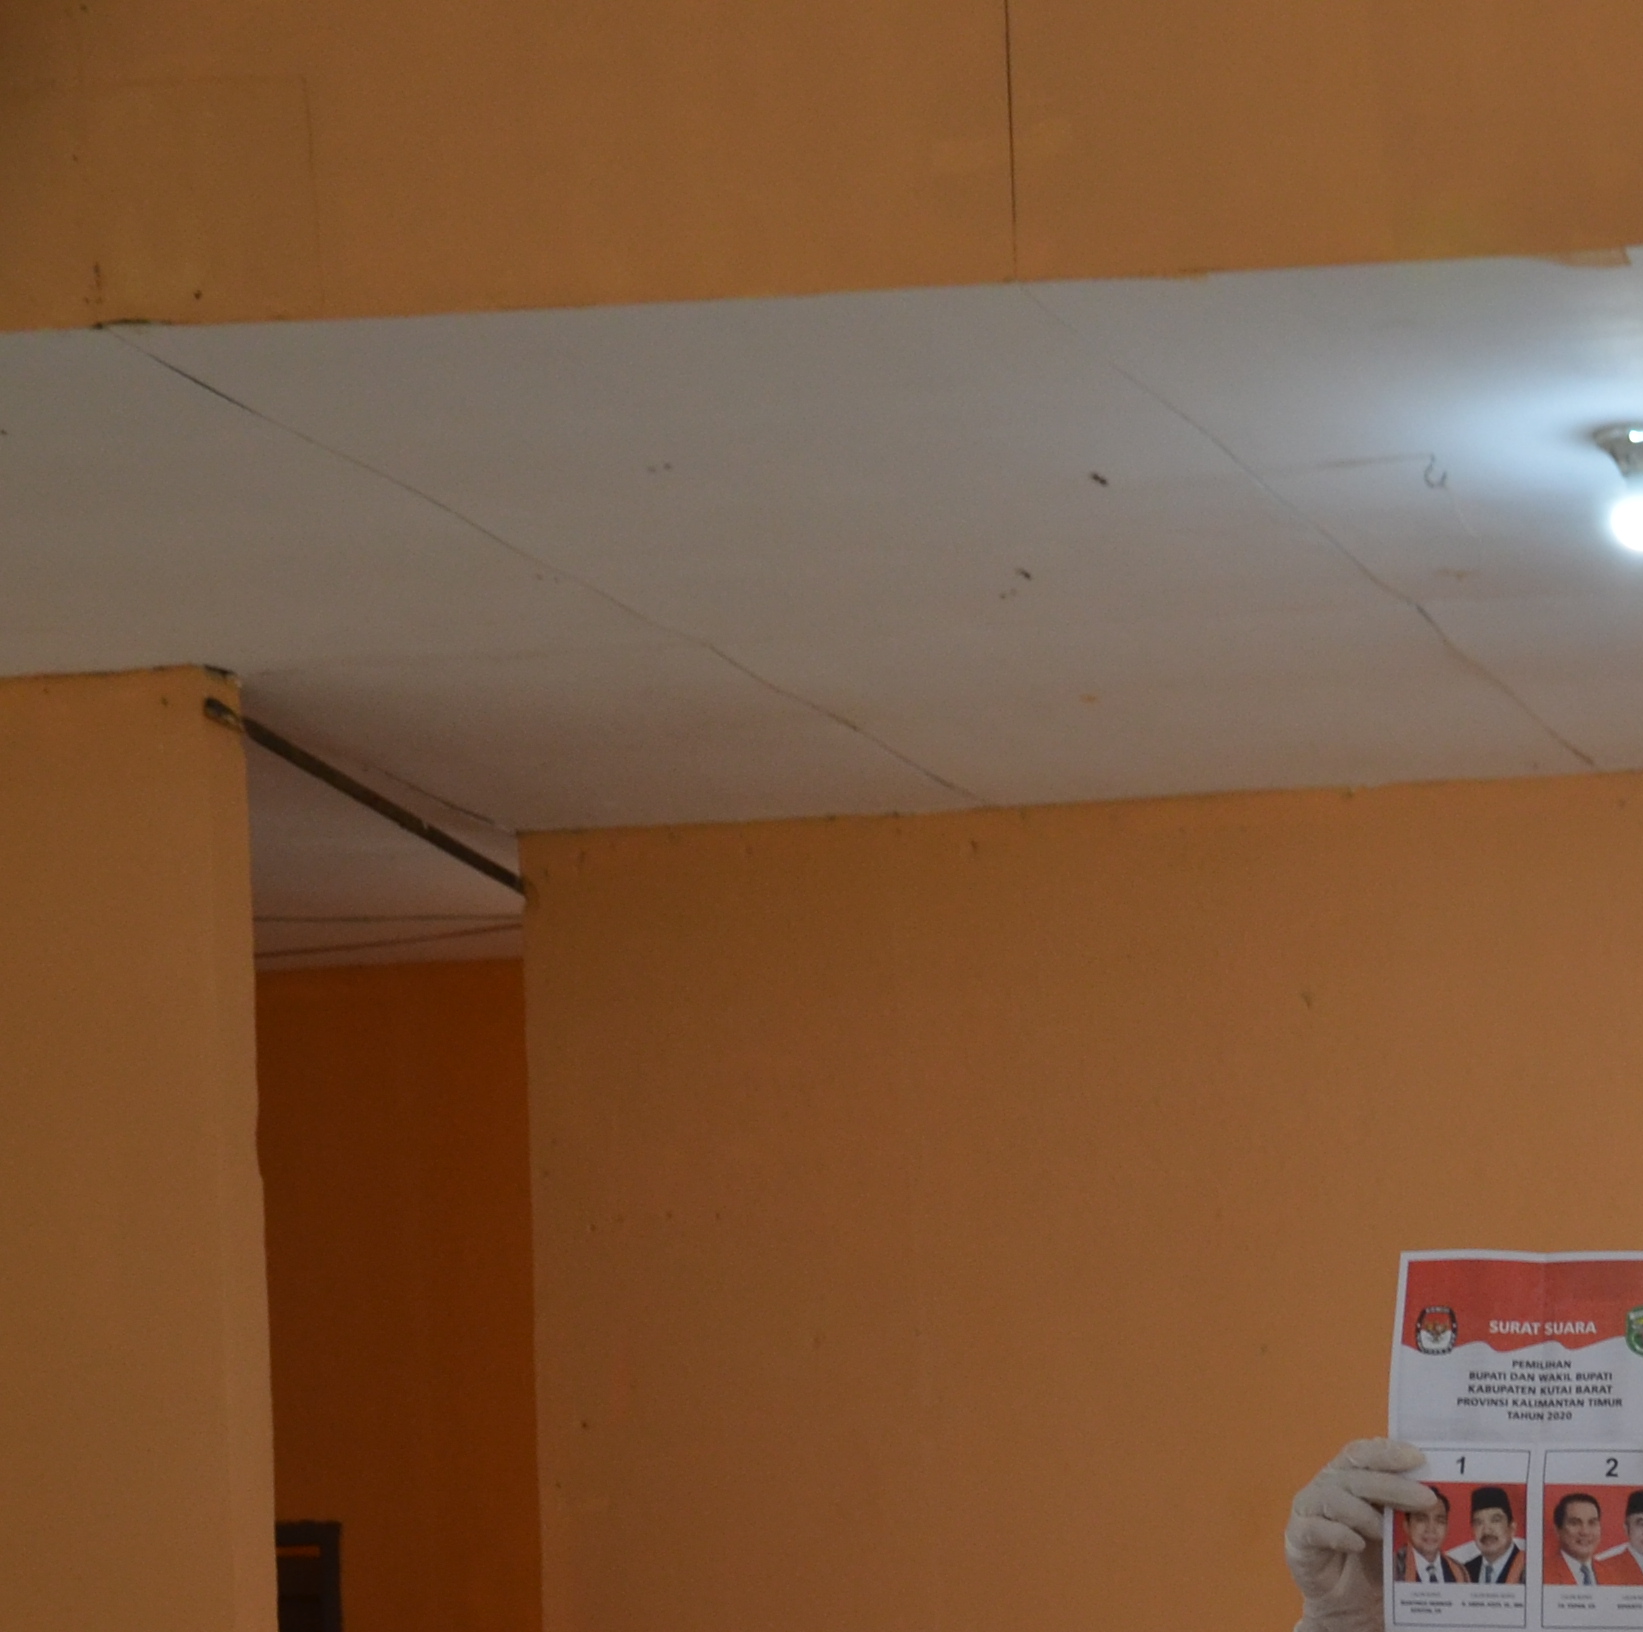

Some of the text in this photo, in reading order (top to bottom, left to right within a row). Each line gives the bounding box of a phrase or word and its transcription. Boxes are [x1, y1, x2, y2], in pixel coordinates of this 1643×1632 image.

[1489, 1320, 1596, 1335] SURAT SUARA
[1512, 1360, 1571, 1369] PEMILIHAN
[1469, 1372, 1613, 1382] BUPATI DAN WAKIL BUPATI
[1468, 1384, 1612, 1395] KABUPATEN KUTAI BARAT
[1457, 1398, 1623, 1408] PROVINSI KALIMANTAN TIMUR
[1507, 1411, 1572, 1420] TAHUN 2020
[1457, 1456, 1466, 1474] 1
[1605, 1458, 1619, 1477] 2
